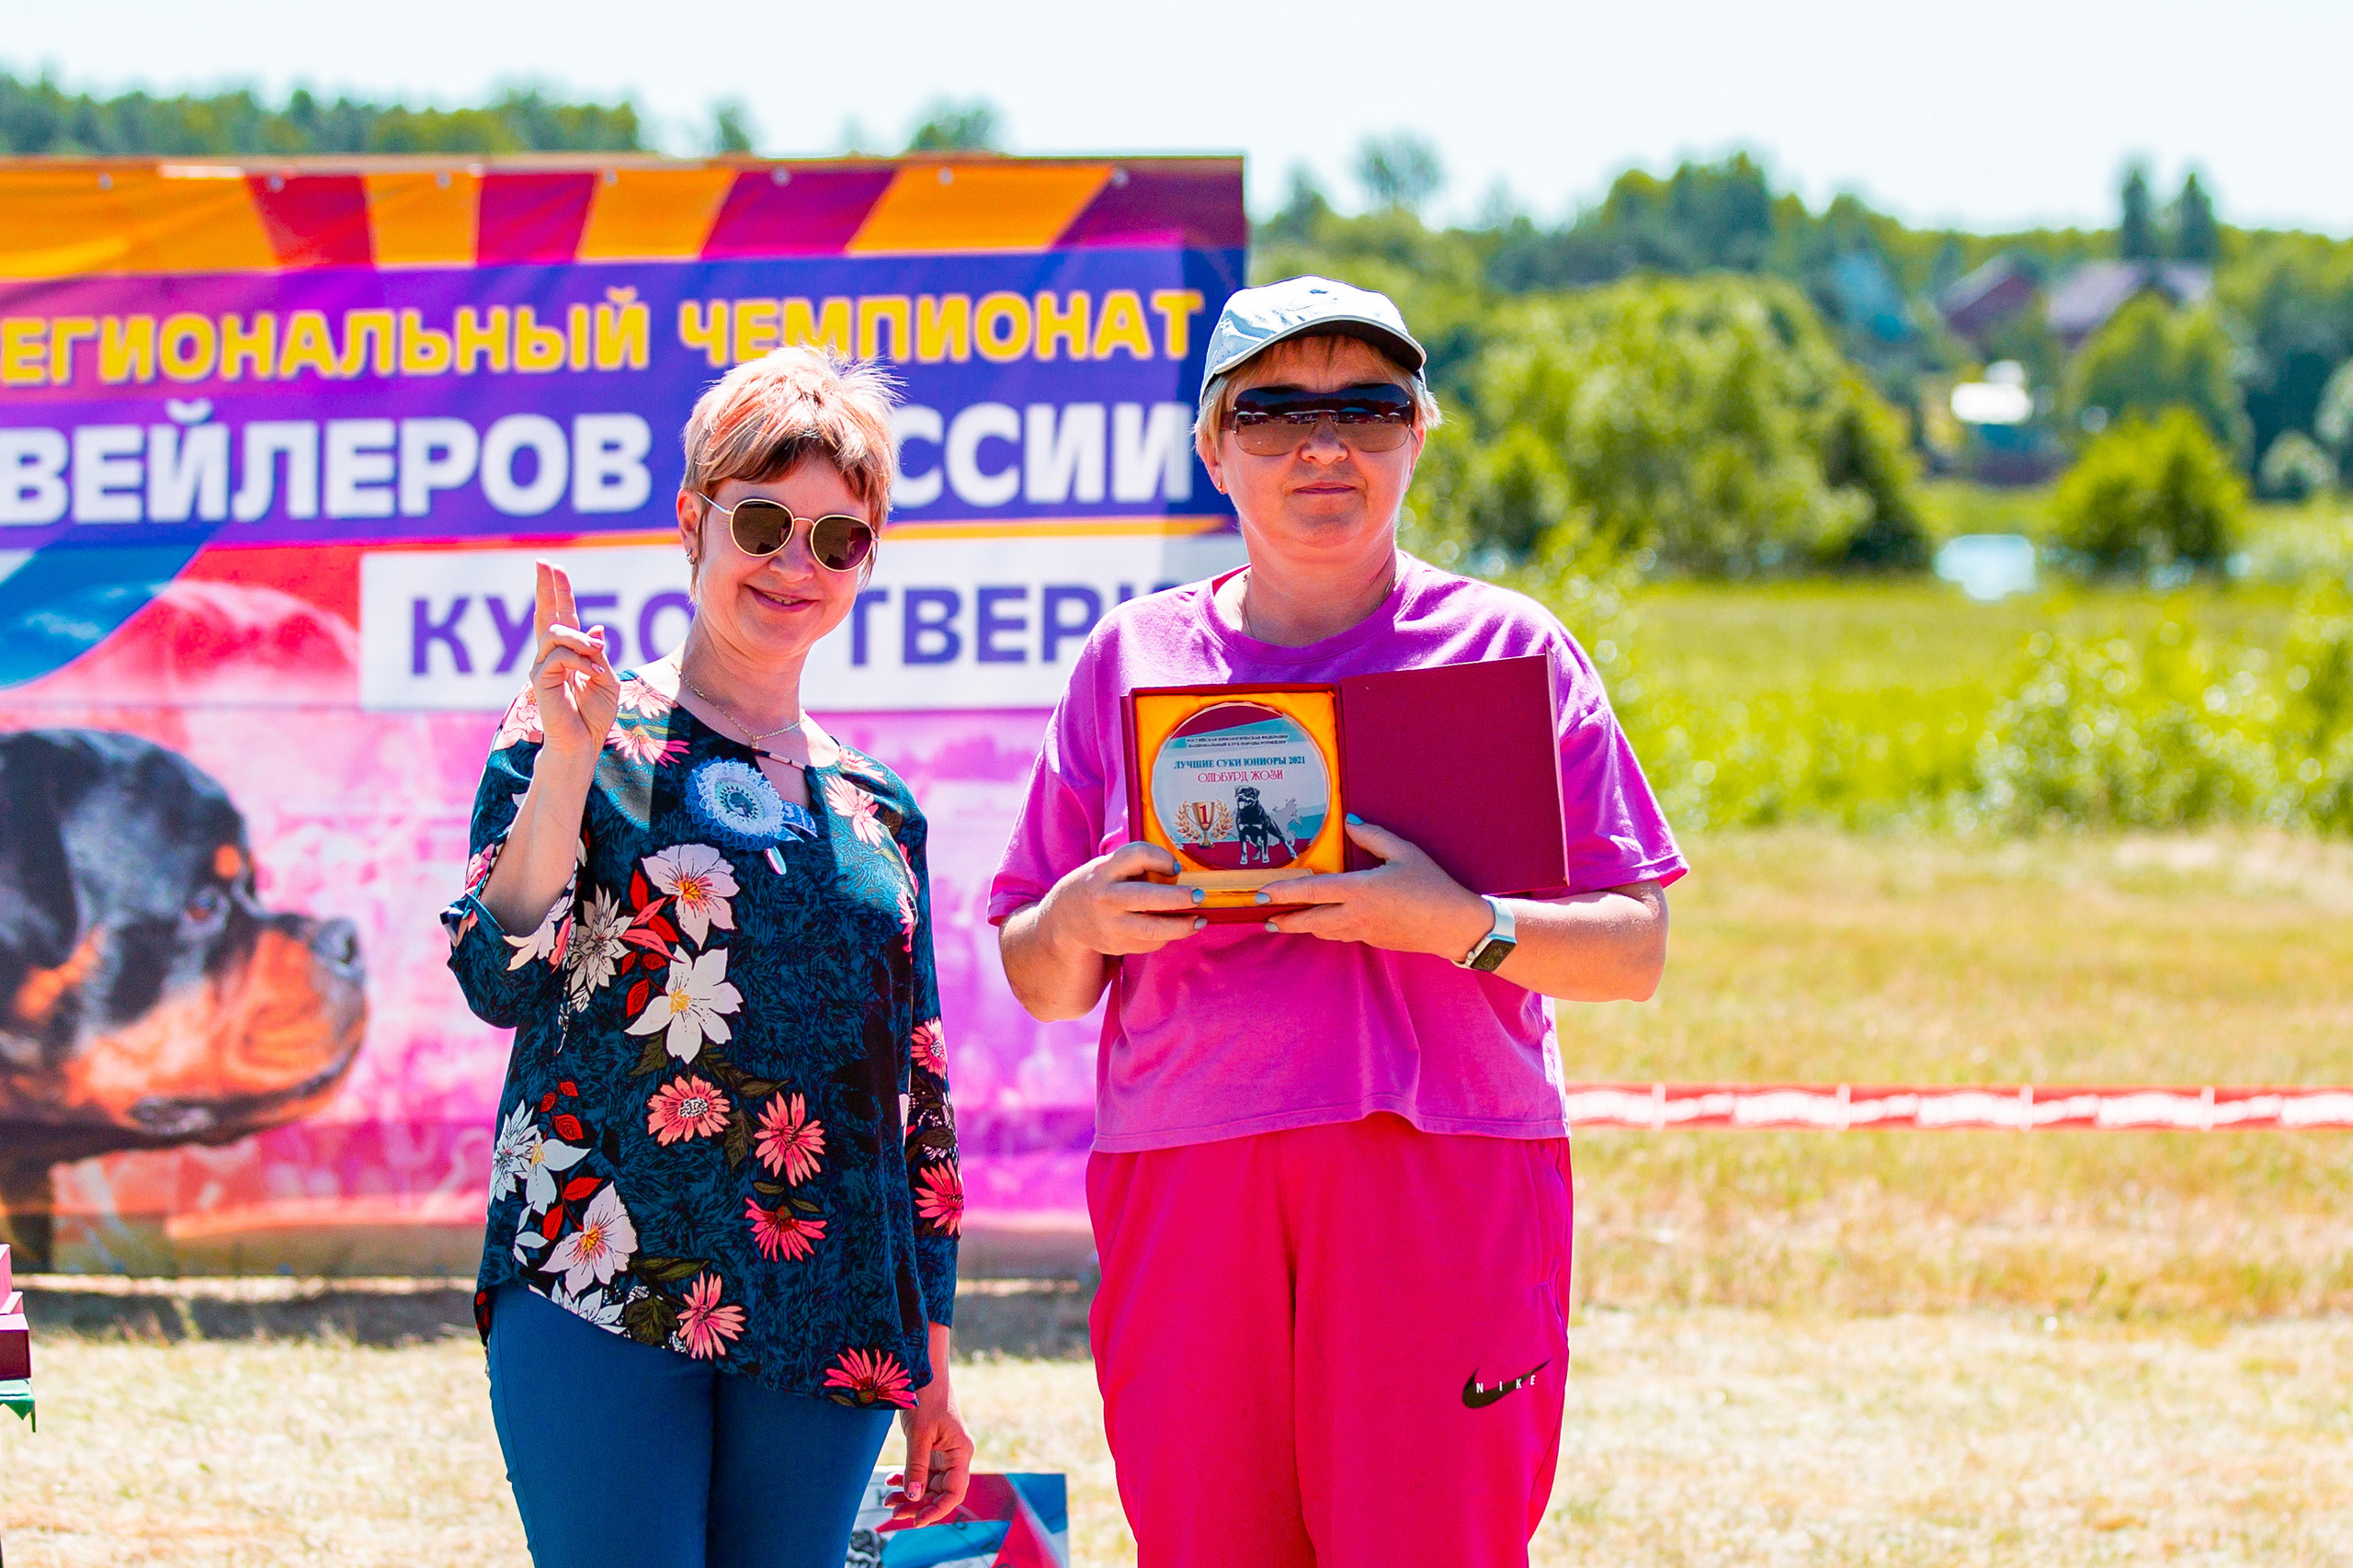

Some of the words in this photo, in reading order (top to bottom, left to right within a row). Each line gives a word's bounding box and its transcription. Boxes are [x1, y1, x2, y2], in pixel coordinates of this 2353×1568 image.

[0, 286, 651, 384] ЕГИОНАЛЬНЫЙ
[678, 289, 1205, 366] ЧЕМПИОНАТ
[0, 399, 654, 526] ВЕЙЛЕРОВ
[889, 402, 1194, 507] ССИИ
[410, 589, 697, 676] КУБО
[850, 581, 1183, 667] ТВЕР
[1174, 759, 1214, 769] ЛУЧШИЕ
[1216, 758, 1242, 767] СУКИ
[1244, 756, 1287, 767] ЮНИОРЫ
[1288, 756, 1306, 765] 2021
[1199, 804, 1211, 824] 1
[1475, 1375, 1536, 1393] NIKE
